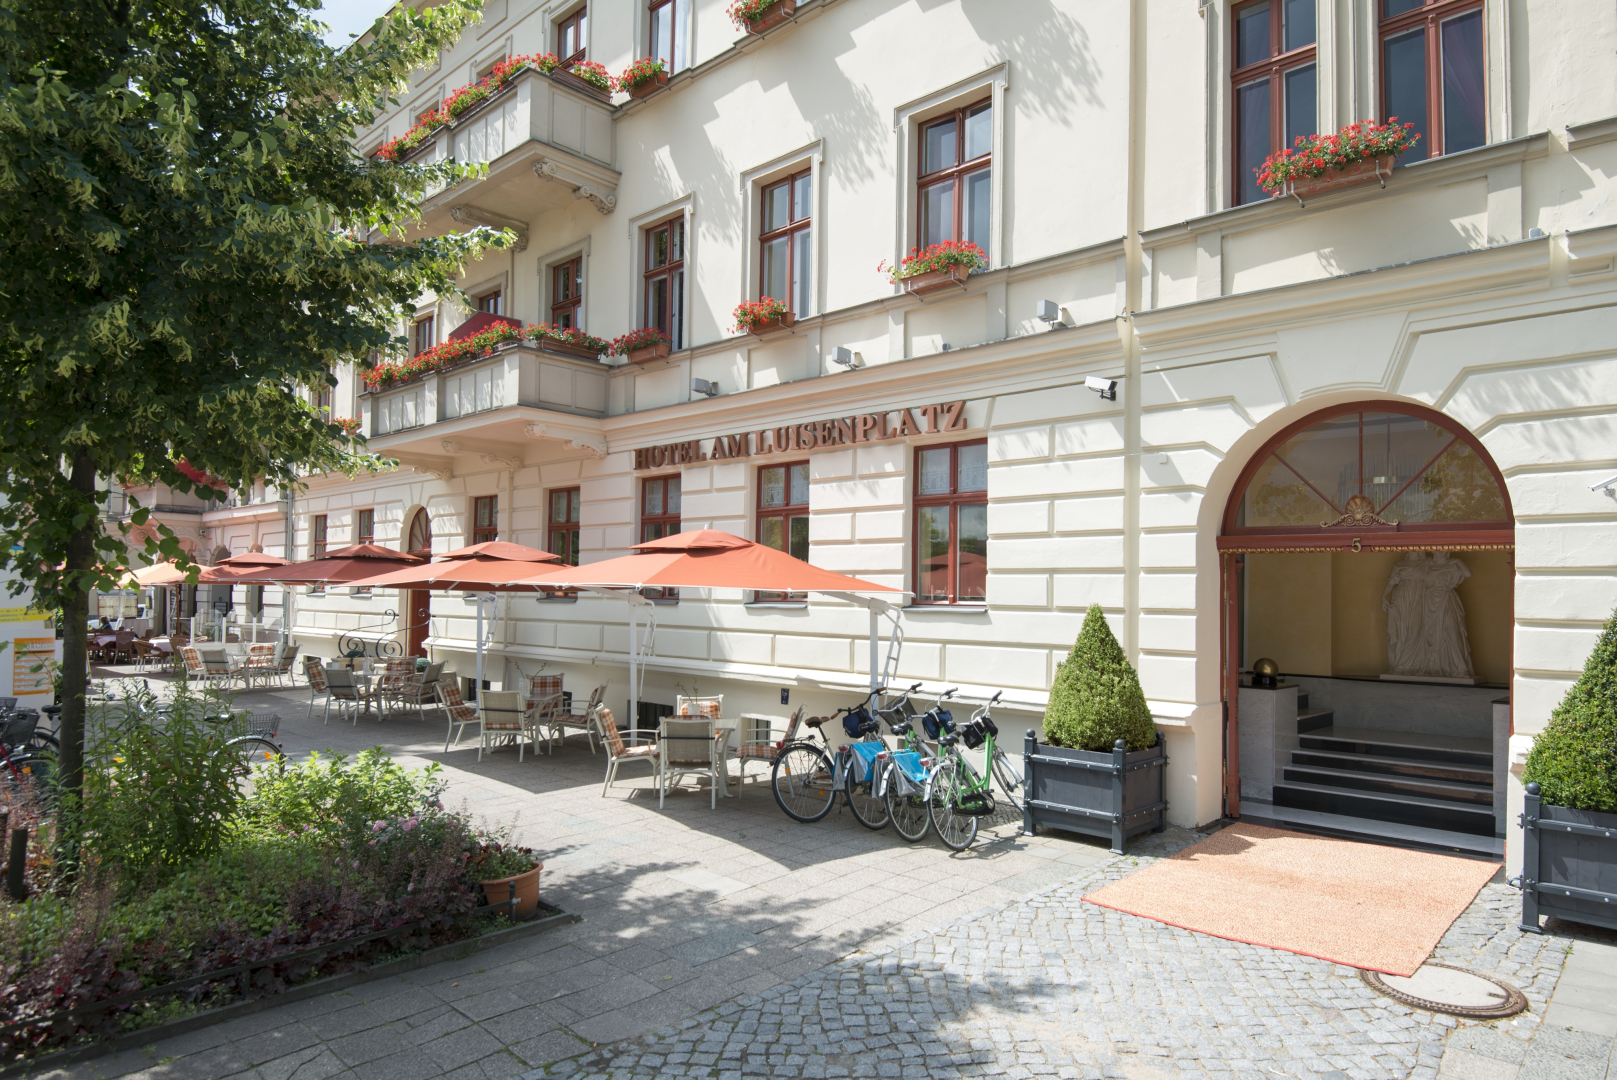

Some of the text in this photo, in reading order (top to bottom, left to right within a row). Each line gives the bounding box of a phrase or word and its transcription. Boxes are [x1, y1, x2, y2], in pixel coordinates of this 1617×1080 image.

[633, 400, 968, 470] HOTEL AM LUISENPLATZ
[1351, 537, 1362, 553] 5
